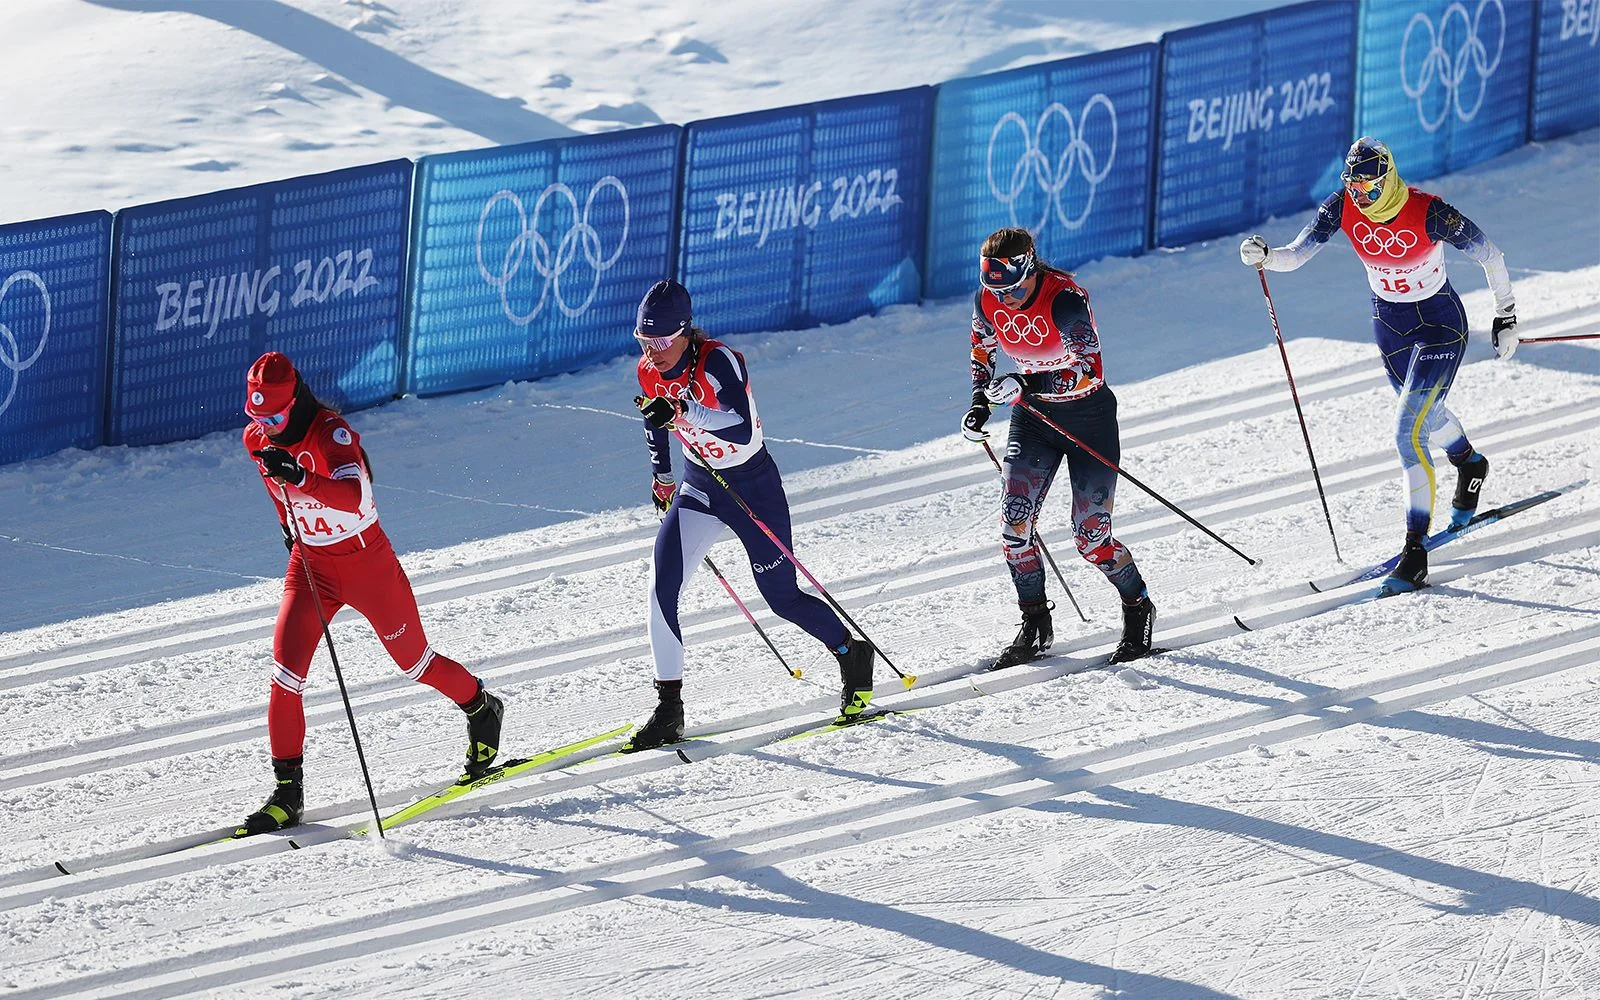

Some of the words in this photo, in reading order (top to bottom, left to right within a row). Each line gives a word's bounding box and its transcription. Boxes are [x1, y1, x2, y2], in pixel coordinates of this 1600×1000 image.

[1187, 86, 1274, 150] BEIJING
[1279, 72, 1335, 124] 2022
[714, 181, 822, 248] BEIJING
[829, 168, 903, 222] 2022
[155, 265, 281, 339] BEIJING
[290, 248, 379, 308] 2022
[1380, 278, 1411, 293] 15
[1036, 353, 1071, 366] 2022
[1419, 352, 1450, 361] CRAFT
[711, 470, 729, 489] LEKI
[298, 516, 333, 536] 14
[336, 523, 347, 533] 1
[1142, 612, 1151, 647] ATOMIC
[470, 771, 505, 791] FISCHER
